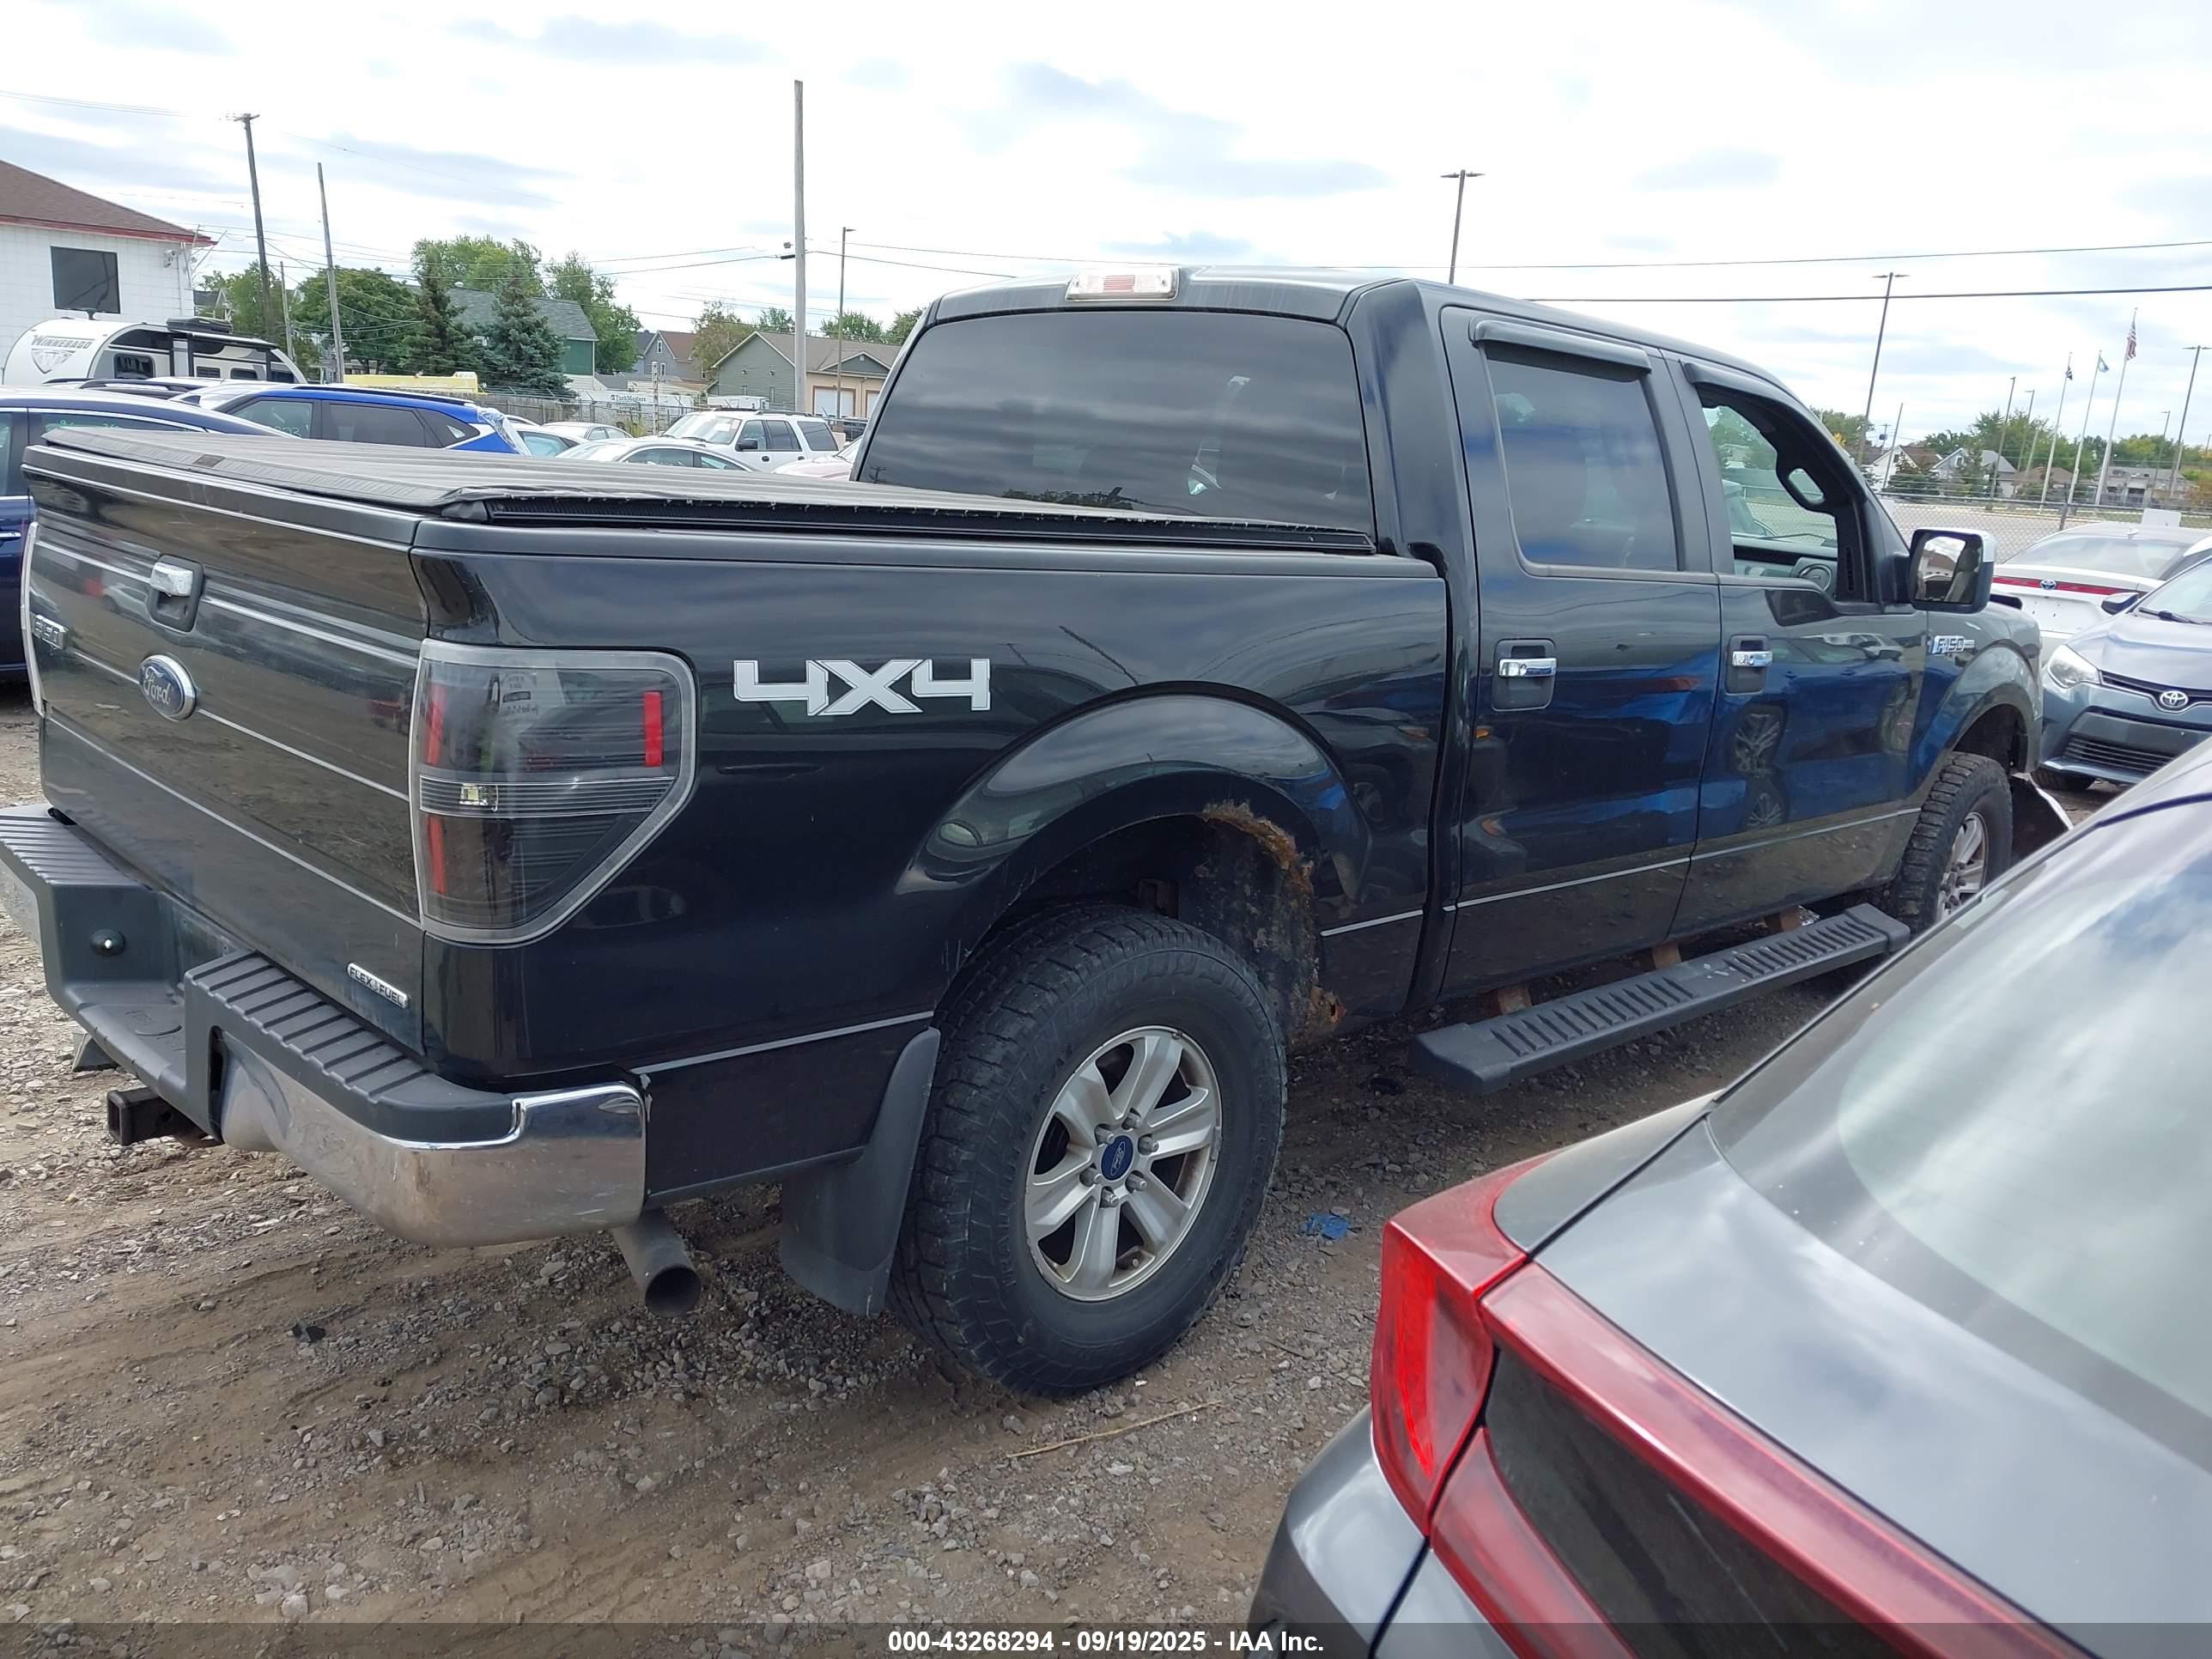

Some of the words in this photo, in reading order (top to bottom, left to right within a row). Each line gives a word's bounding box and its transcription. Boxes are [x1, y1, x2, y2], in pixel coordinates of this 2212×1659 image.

[31, 335, 93, 349] WINNEBAGO
[143, 665, 172, 705] Ford
[349, 967, 372, 988] FLEX
[379, 982, 405, 1007] FUEL
